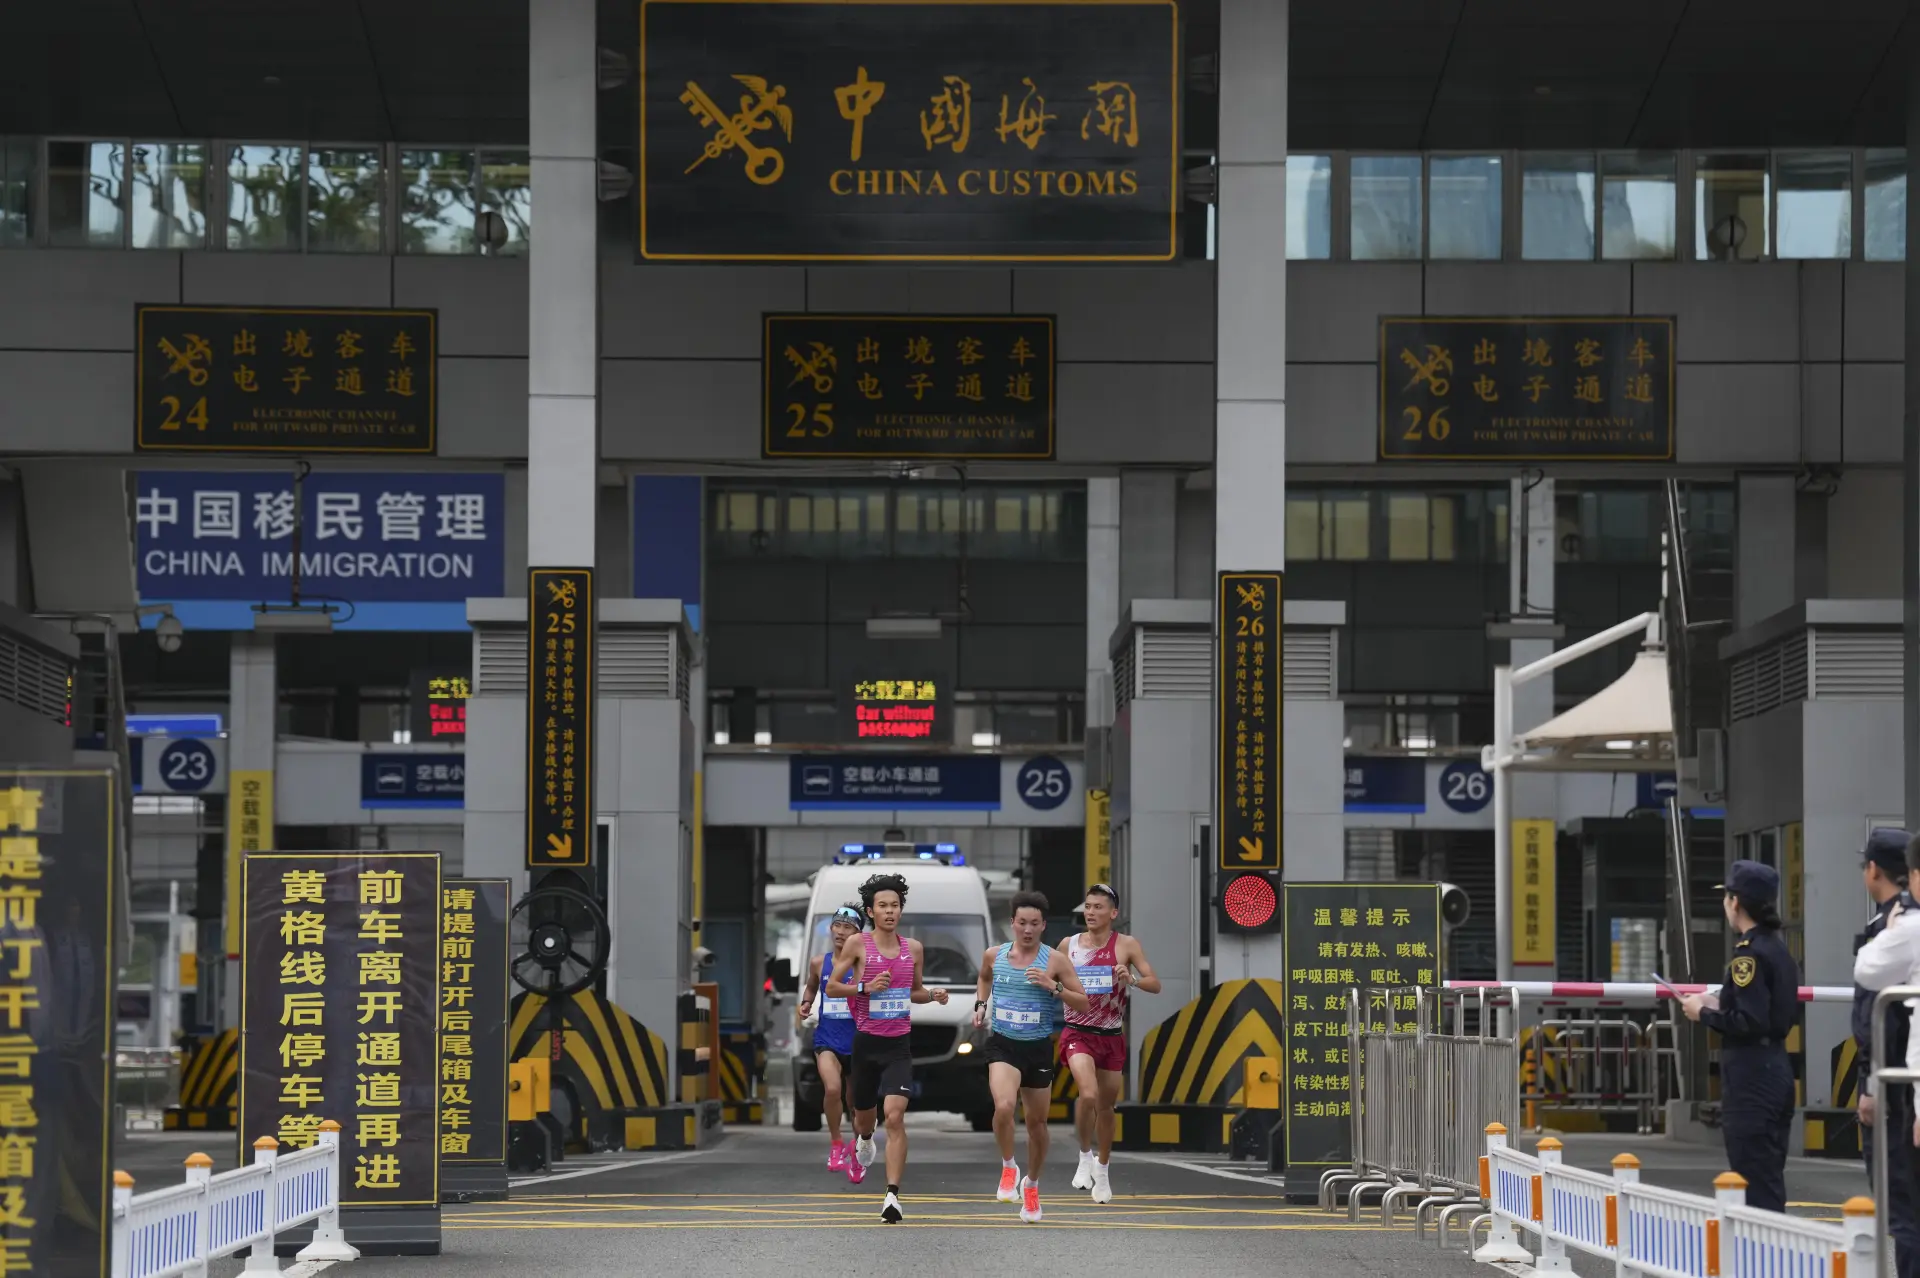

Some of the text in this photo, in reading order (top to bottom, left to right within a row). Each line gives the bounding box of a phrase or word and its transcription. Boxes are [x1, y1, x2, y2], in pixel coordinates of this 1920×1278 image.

[830, 169, 1138, 195] CHINA CUSTOMS
[233, 329, 415, 360] 出境客车
[856, 336, 1033, 366] 出境客车
[1473, 337, 1655, 368] 出境客车
[232, 365, 417, 397] 电子通道
[856, 372, 1034, 401] 电子通道
[1472, 373, 1655, 403] 电子通道
[161, 396, 208, 430] 24
[251, 405, 398, 421] ELECTRONIC CHANNEL
[787, 403, 833, 437] 25
[875, 414, 1016, 426] ELECTRONIC CHANNEL
[1403, 406, 1450, 440] 26
[1492, 418, 1634, 427] ELECTRONIC CHANNEL
[232, 421, 418, 434] FOR OUTWARD PRIVATE CAR
[856, 427, 1035, 439] FOR OUTWARD PRIVATE CAR
[1473, 430, 1655, 441] FOR OUTWARD PRIVATE CAR
[136, 488, 486, 541] 中国移民管理
[145, 550, 472, 577] CHINA IMMIGRATION
[548, 613, 575, 634] 25
[1238, 616, 1264, 636] 26
[856, 705, 934, 720] Car without
[858, 722, 931, 737] passenger
[168, 752, 208, 780] 23
[844, 767, 939, 782] 空载小车通道
[416, 783, 434, 793] Car
[843, 784, 944, 797] Car without Passenger
[1025, 769, 1064, 797] 25
[1447, 772, 1487, 800] 26
[1314, 908, 1410, 926] 温馨提示
[1318, 942, 1435, 959] 请有发热、咳嗽、
[1292, 968, 1432, 984] 呼吸困难、呕吐、腹
[277, 869, 328, 1149] 黄格线后停车等
[355, 870, 404, 1188] 前车离开通道再进
[442, 889, 475, 1154] 请提前打开后尾箱及车窗
[1293, 1074, 1364, 1090] 传染性疾
[1293, 1100, 1364, 1117] 主动向海
